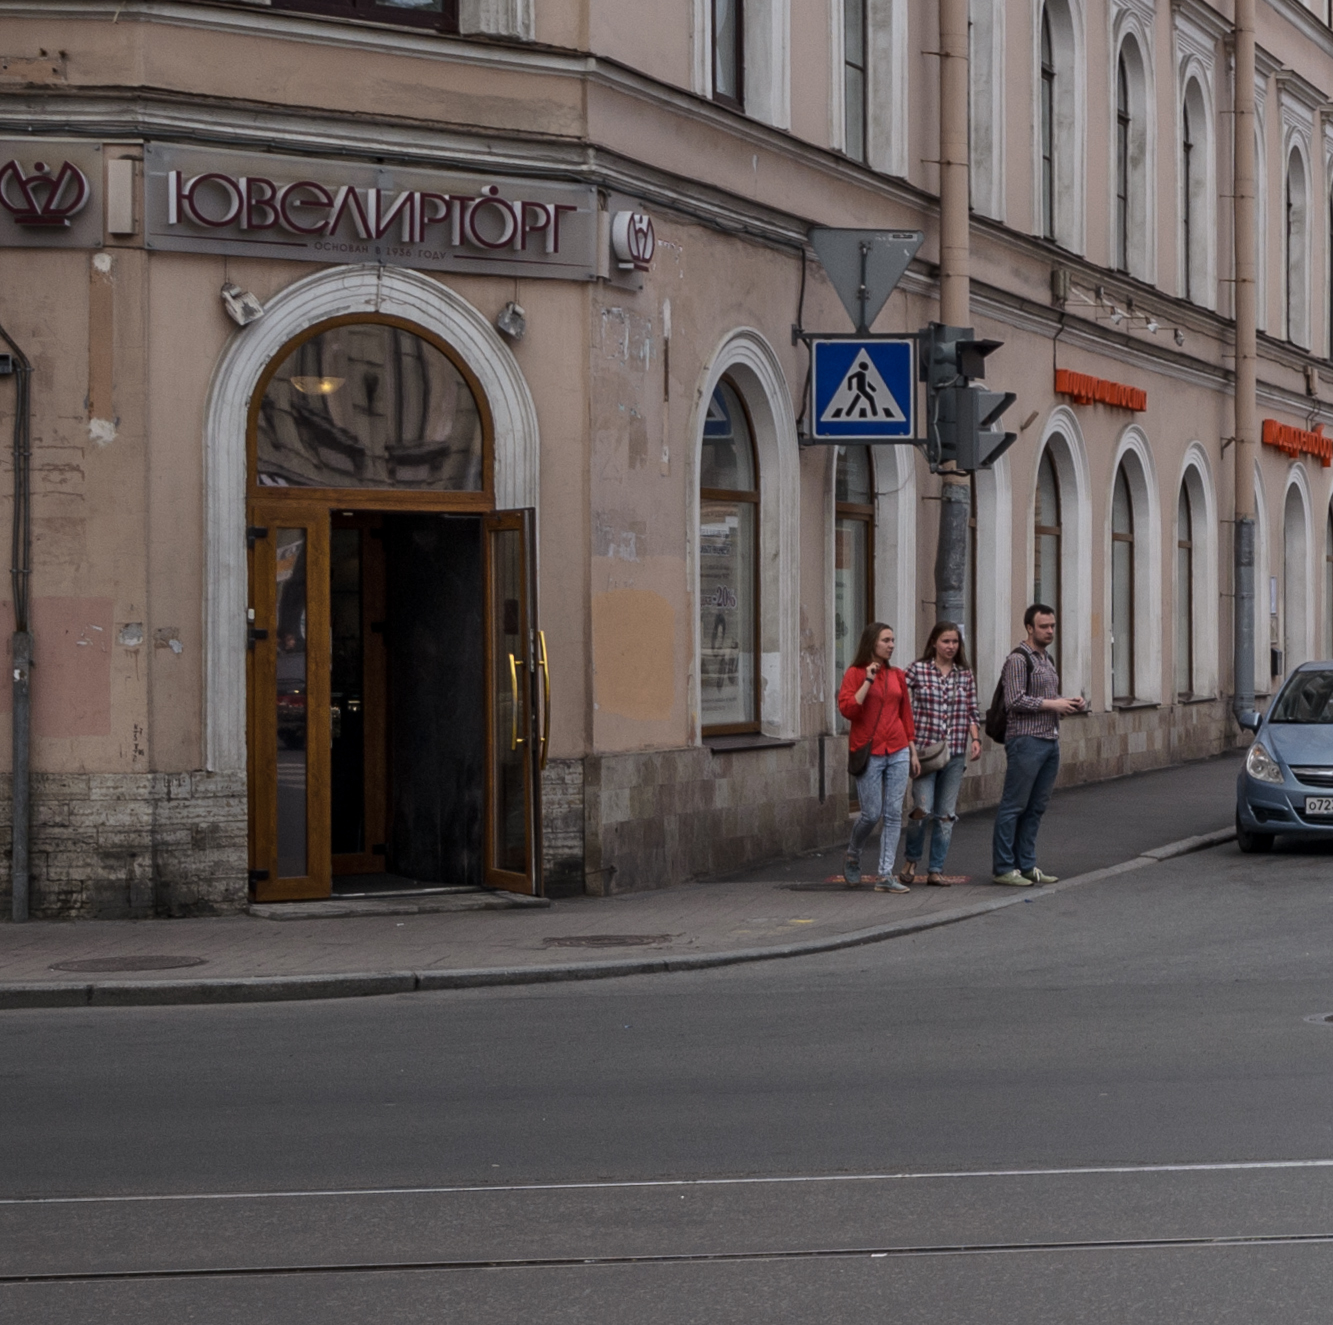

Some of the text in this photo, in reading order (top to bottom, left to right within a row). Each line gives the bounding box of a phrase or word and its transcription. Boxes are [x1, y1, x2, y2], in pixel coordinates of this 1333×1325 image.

[168, 170, 578, 254] ЮВЕЛИРТОРГ
[314, 241, 369, 254] ОСНОВАН
[418, 249, 447, 261] ГОДУ
